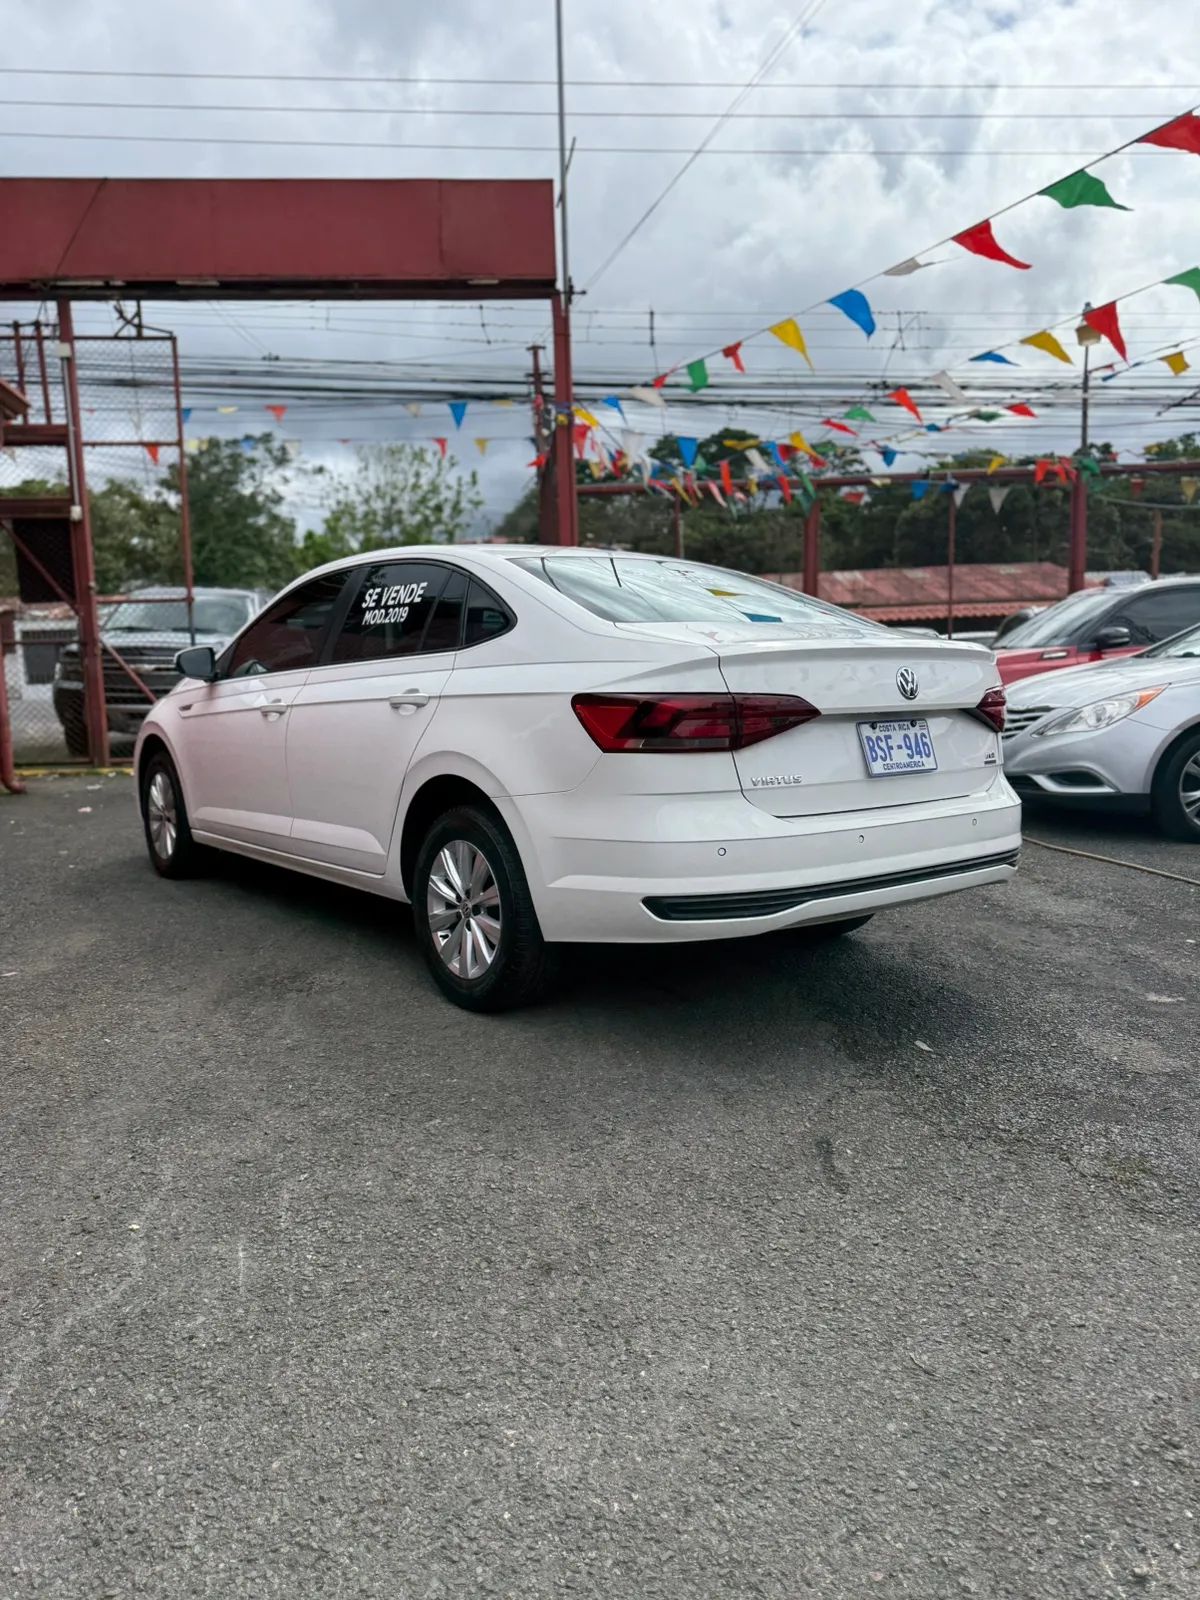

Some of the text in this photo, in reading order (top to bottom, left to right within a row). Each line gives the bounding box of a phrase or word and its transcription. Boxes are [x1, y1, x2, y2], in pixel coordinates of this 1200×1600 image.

[362, 582, 428, 608] SE VENDE
[362, 607, 409, 625] MOD.2019
[878, 724, 897, 732] COSTA
[898, 722, 911, 731] RICA
[865, 732, 932, 763] BSF-946
[883, 760, 926, 771] CENTROAMERICA
[750, 774, 803, 787] VIRTUS
